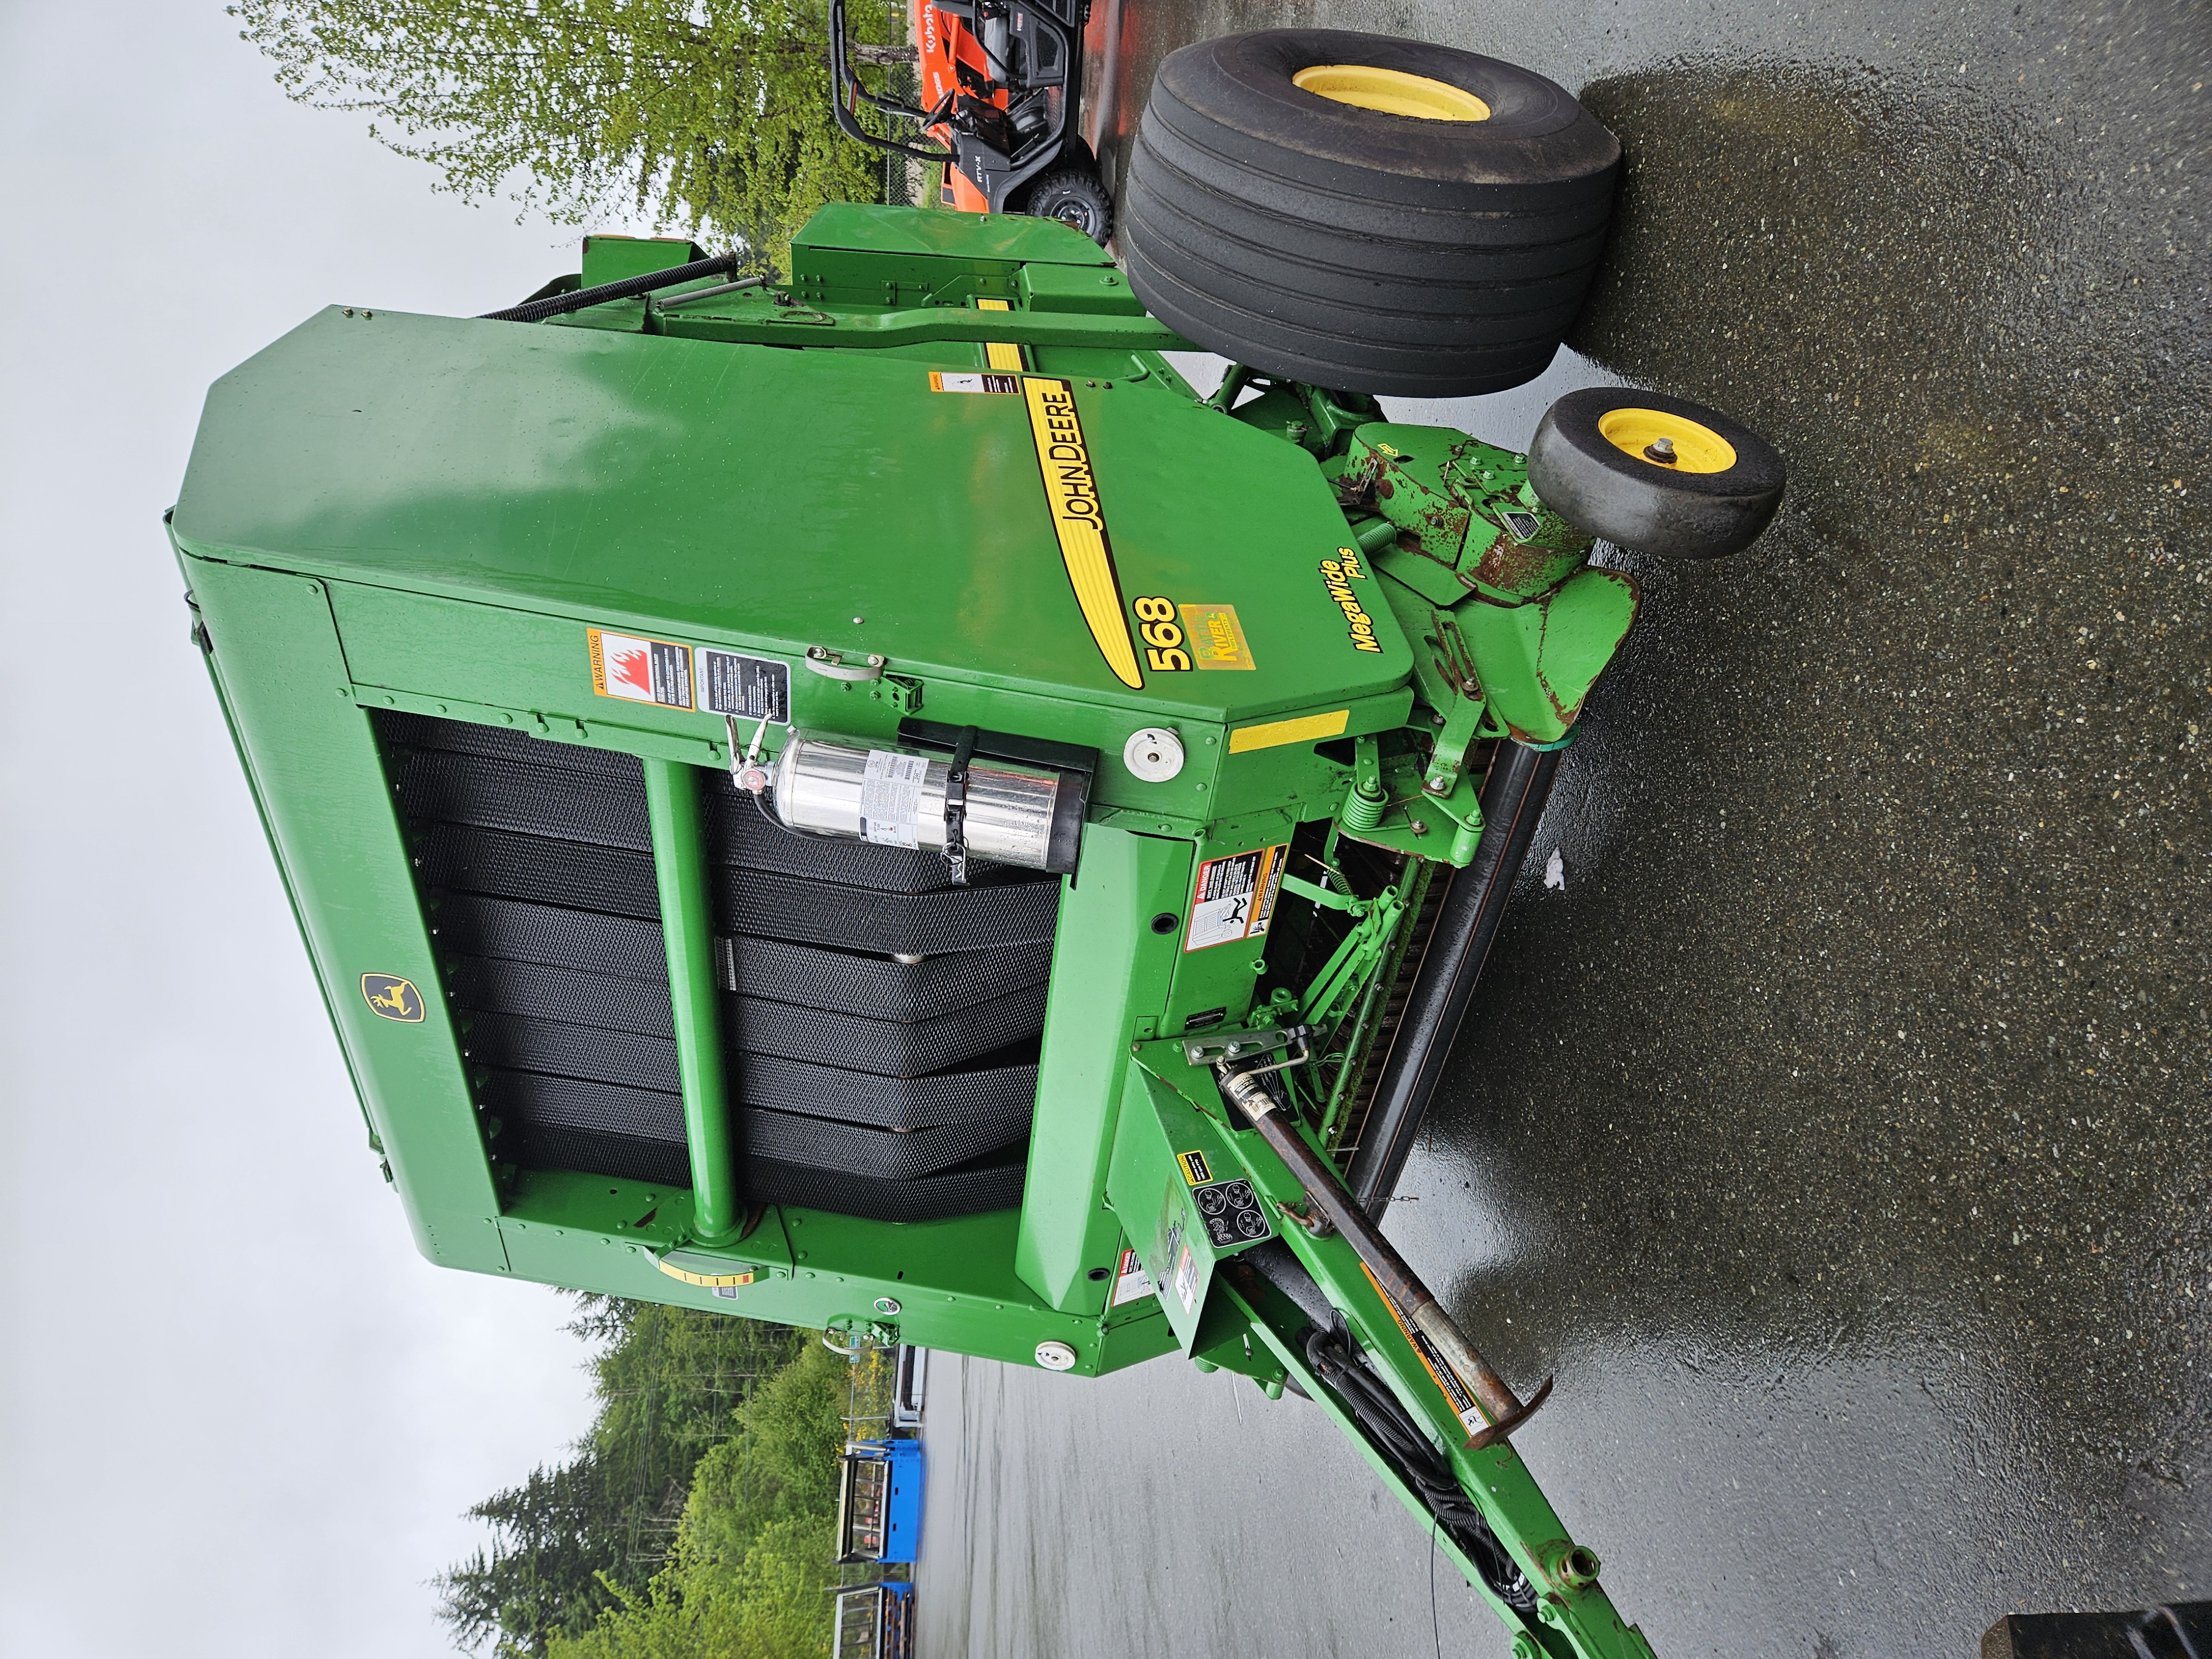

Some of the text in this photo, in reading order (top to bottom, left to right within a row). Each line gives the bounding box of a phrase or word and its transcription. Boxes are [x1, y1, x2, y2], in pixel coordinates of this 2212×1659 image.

[922, 4, 936, 53] Kubota
[974, 155, 983, 183] RTV-X
[1041, 391, 1102, 531] JOHN DEERE
[1337, 546, 1368, 580] Plus
[1318, 560, 1384, 654] MegaWide
[1133, 596, 1193, 671] 568
[1192, 614, 1214, 660] BATTLE
[1207, 620, 1238, 661] RIVER
[1222, 619, 1237, 649] IMPLEMENTS
[590, 635, 603, 681] WARNING
[1199, 865, 1211, 891] DANGER
[1257, 873, 1268, 898] WARNING
[1180, 1156, 1193, 1178] CAUTION
[1397, 1319, 1418, 1349] WARNING
